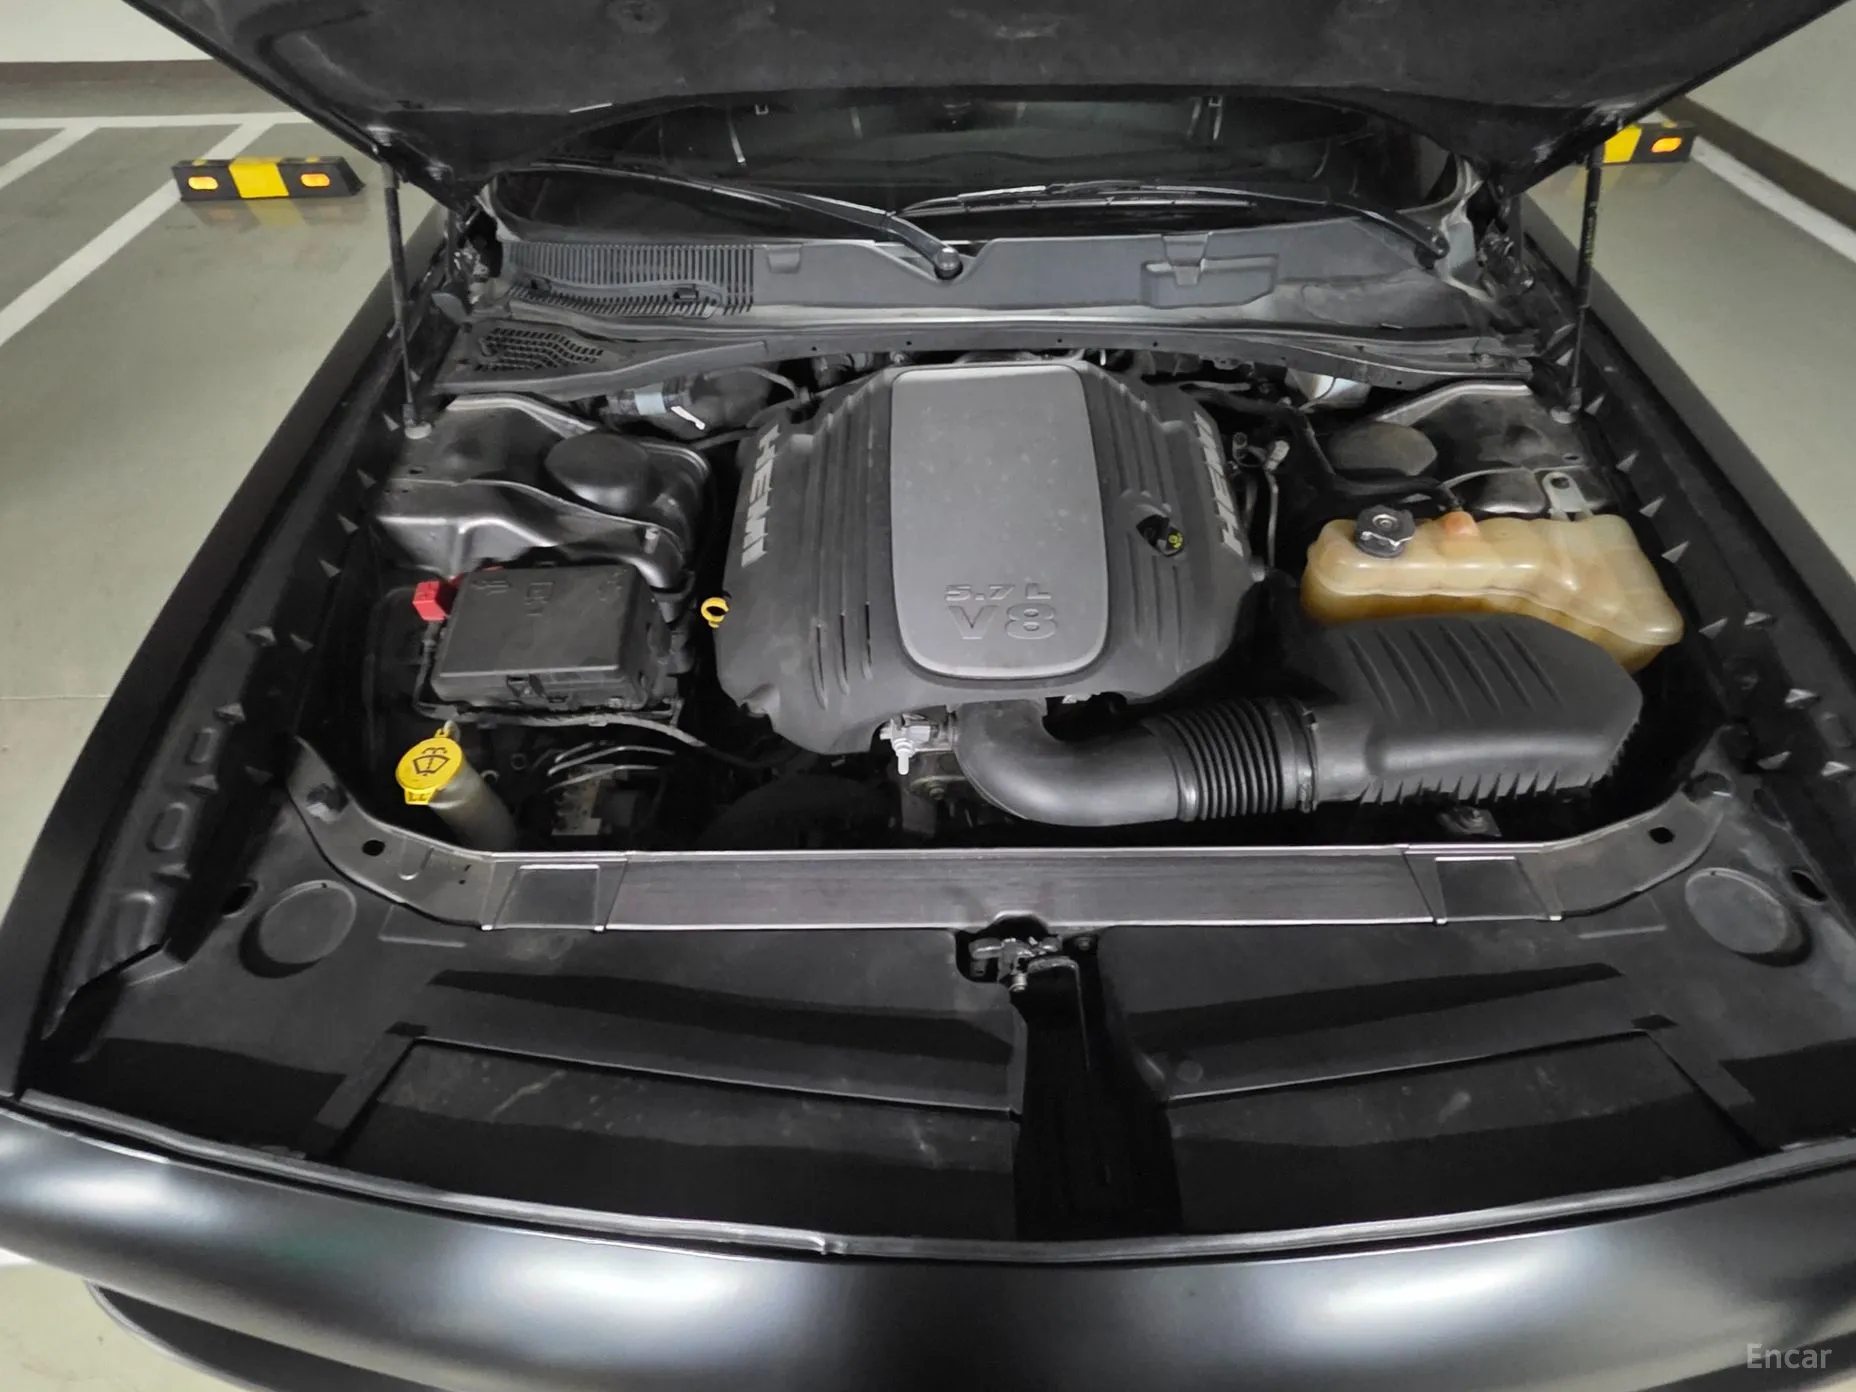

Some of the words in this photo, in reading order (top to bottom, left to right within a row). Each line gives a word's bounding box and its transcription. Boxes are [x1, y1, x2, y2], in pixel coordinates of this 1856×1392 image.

[741, 424, 781, 568] HEMI
[1193, 410, 1244, 557] HEMI
[946, 602, 1058, 640] V8
